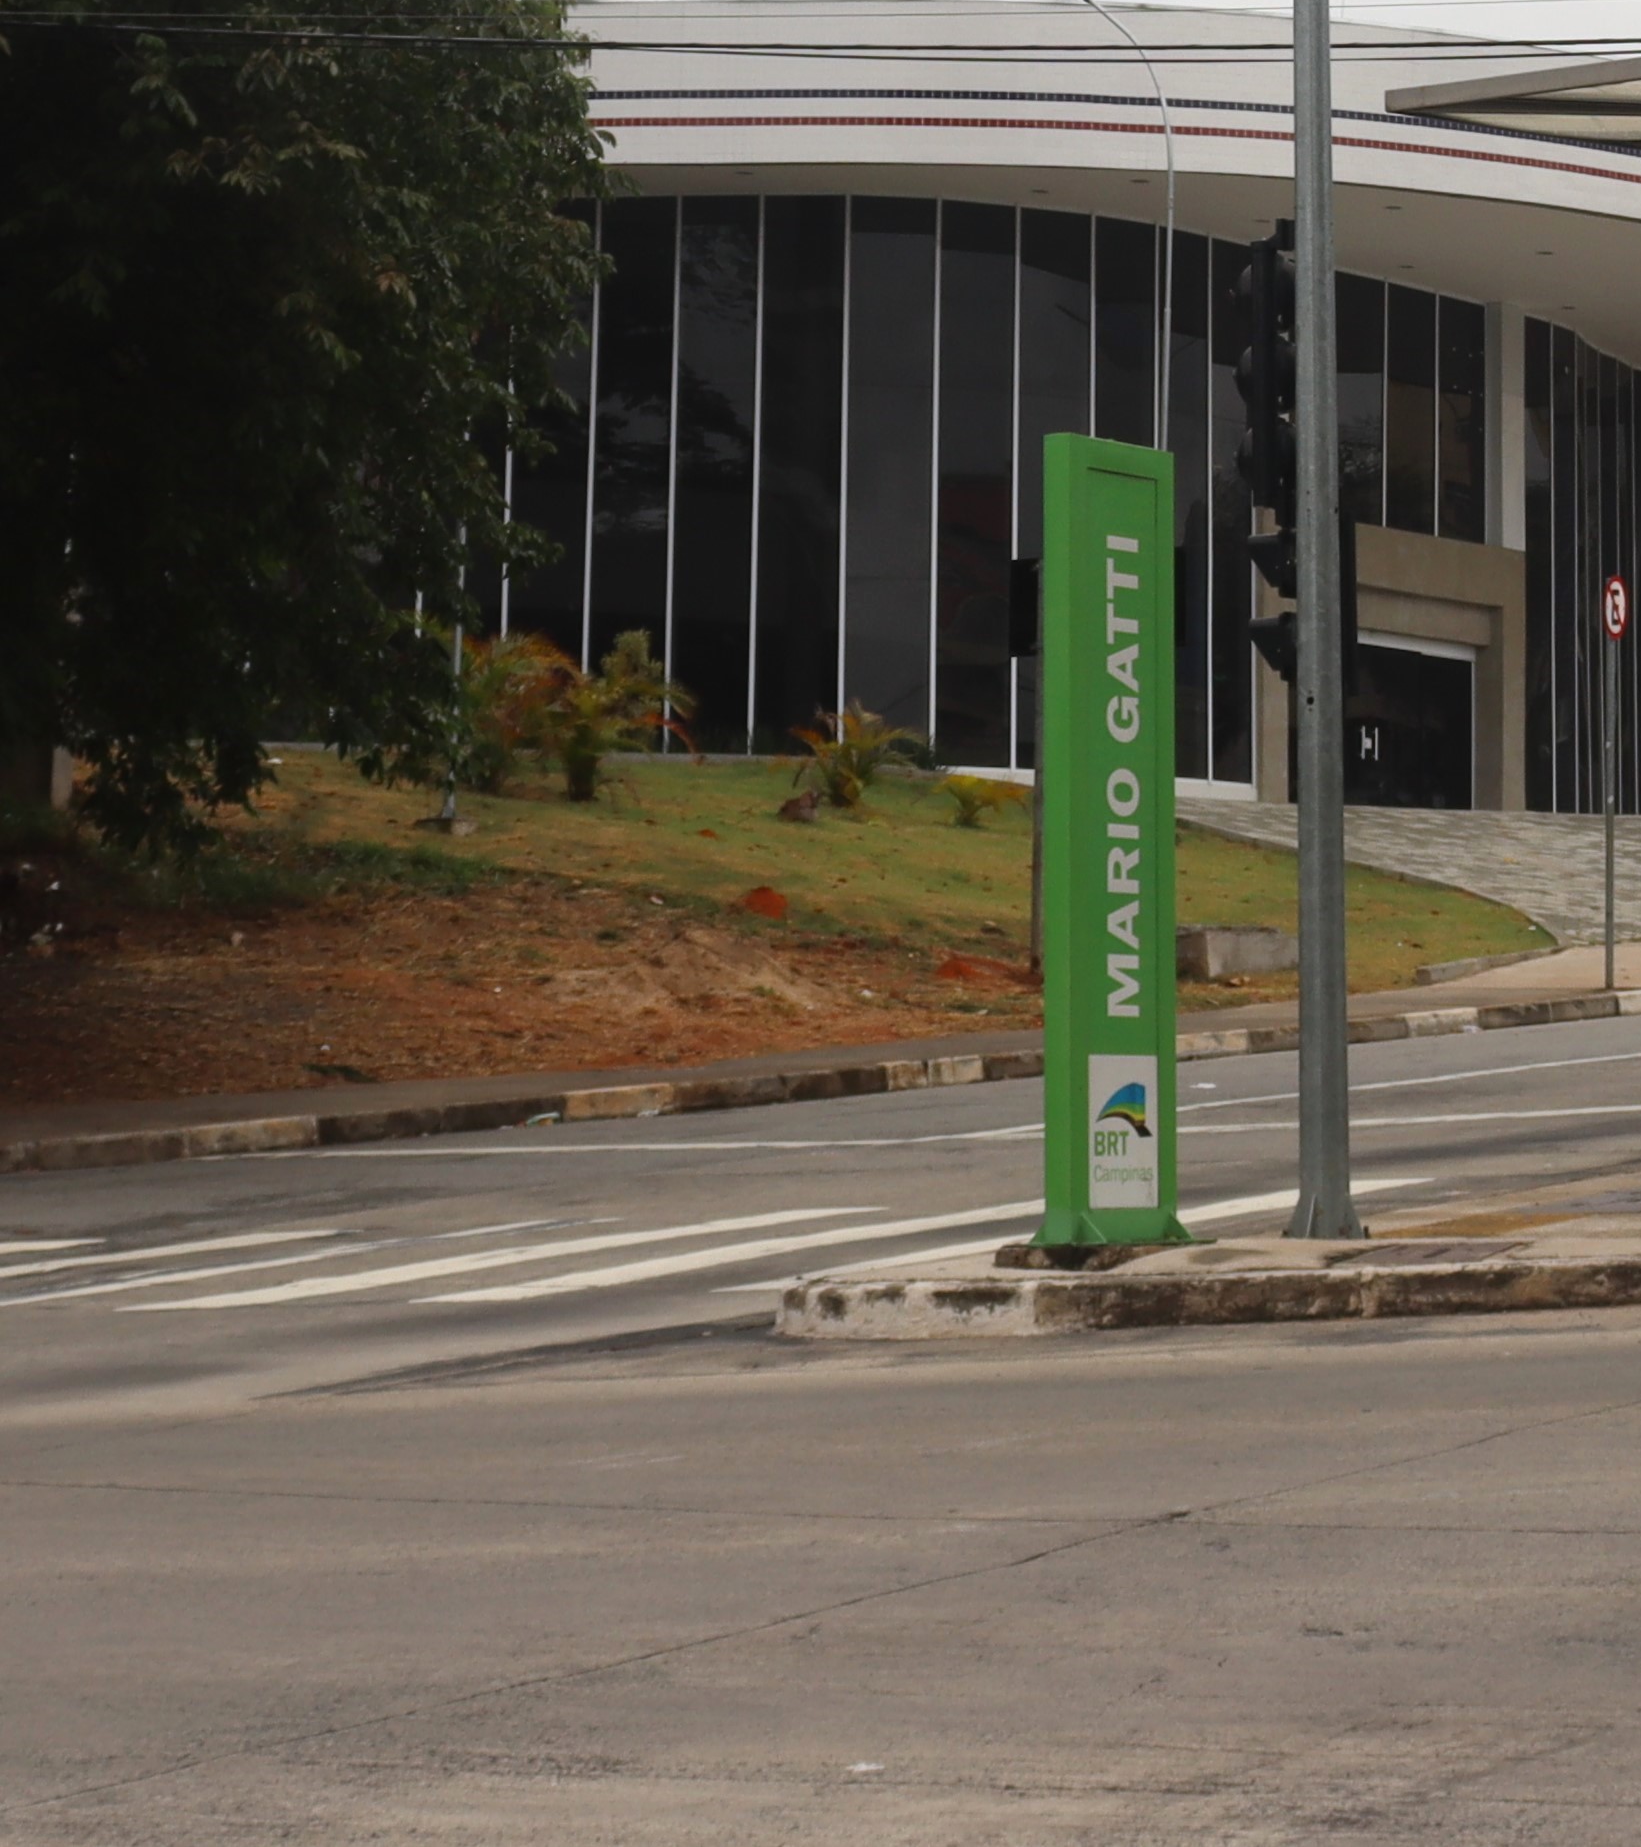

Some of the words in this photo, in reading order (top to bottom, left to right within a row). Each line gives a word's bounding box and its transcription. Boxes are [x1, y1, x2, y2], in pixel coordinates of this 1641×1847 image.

[1106, 535, 1140, 743] GATTI
[1107, 768, 1140, 1017] MARIO
[1094, 1131, 1130, 1157] BRT
[1094, 1164, 1154, 1186] Campinas
